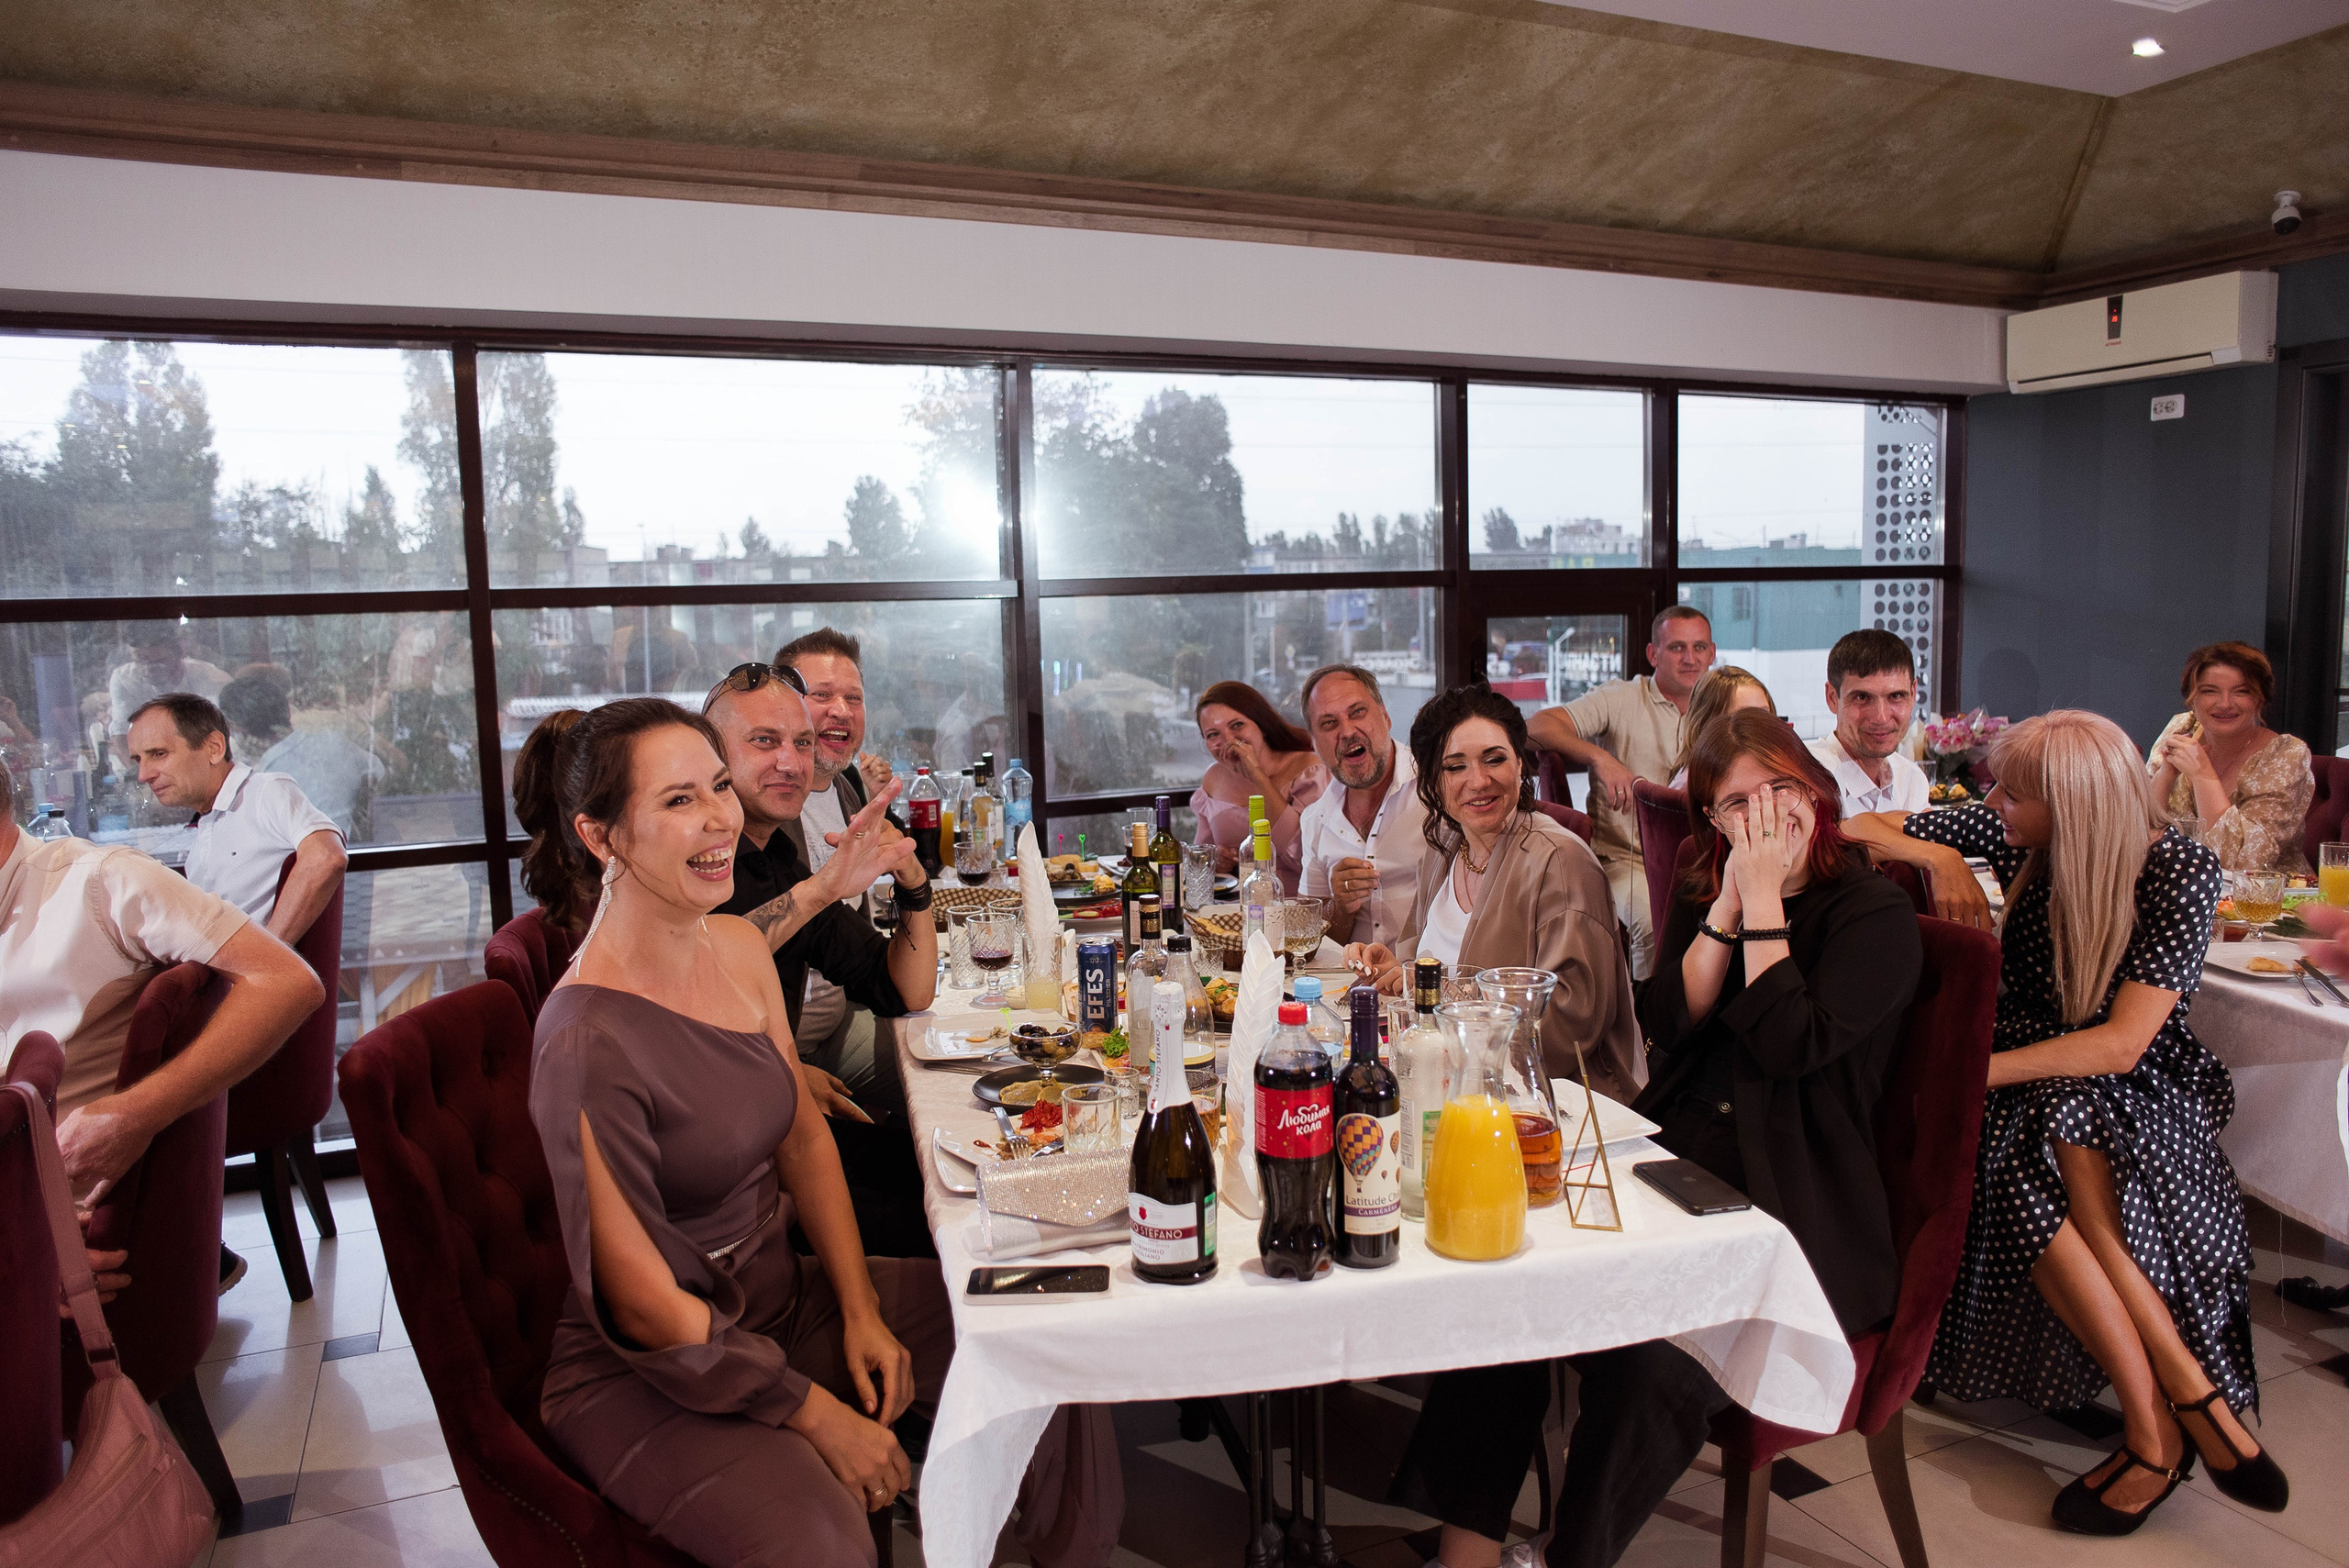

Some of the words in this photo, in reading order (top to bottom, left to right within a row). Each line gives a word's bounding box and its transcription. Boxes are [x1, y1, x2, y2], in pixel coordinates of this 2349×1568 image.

[1085, 968, 1105, 1018] EFES
[1276, 1103, 1330, 1130] Любимая
[1296, 1119, 1322, 1136] кола
[1345, 1194, 1386, 1207] Latitude
[1140, 1226, 1183, 1240] STEFANO
